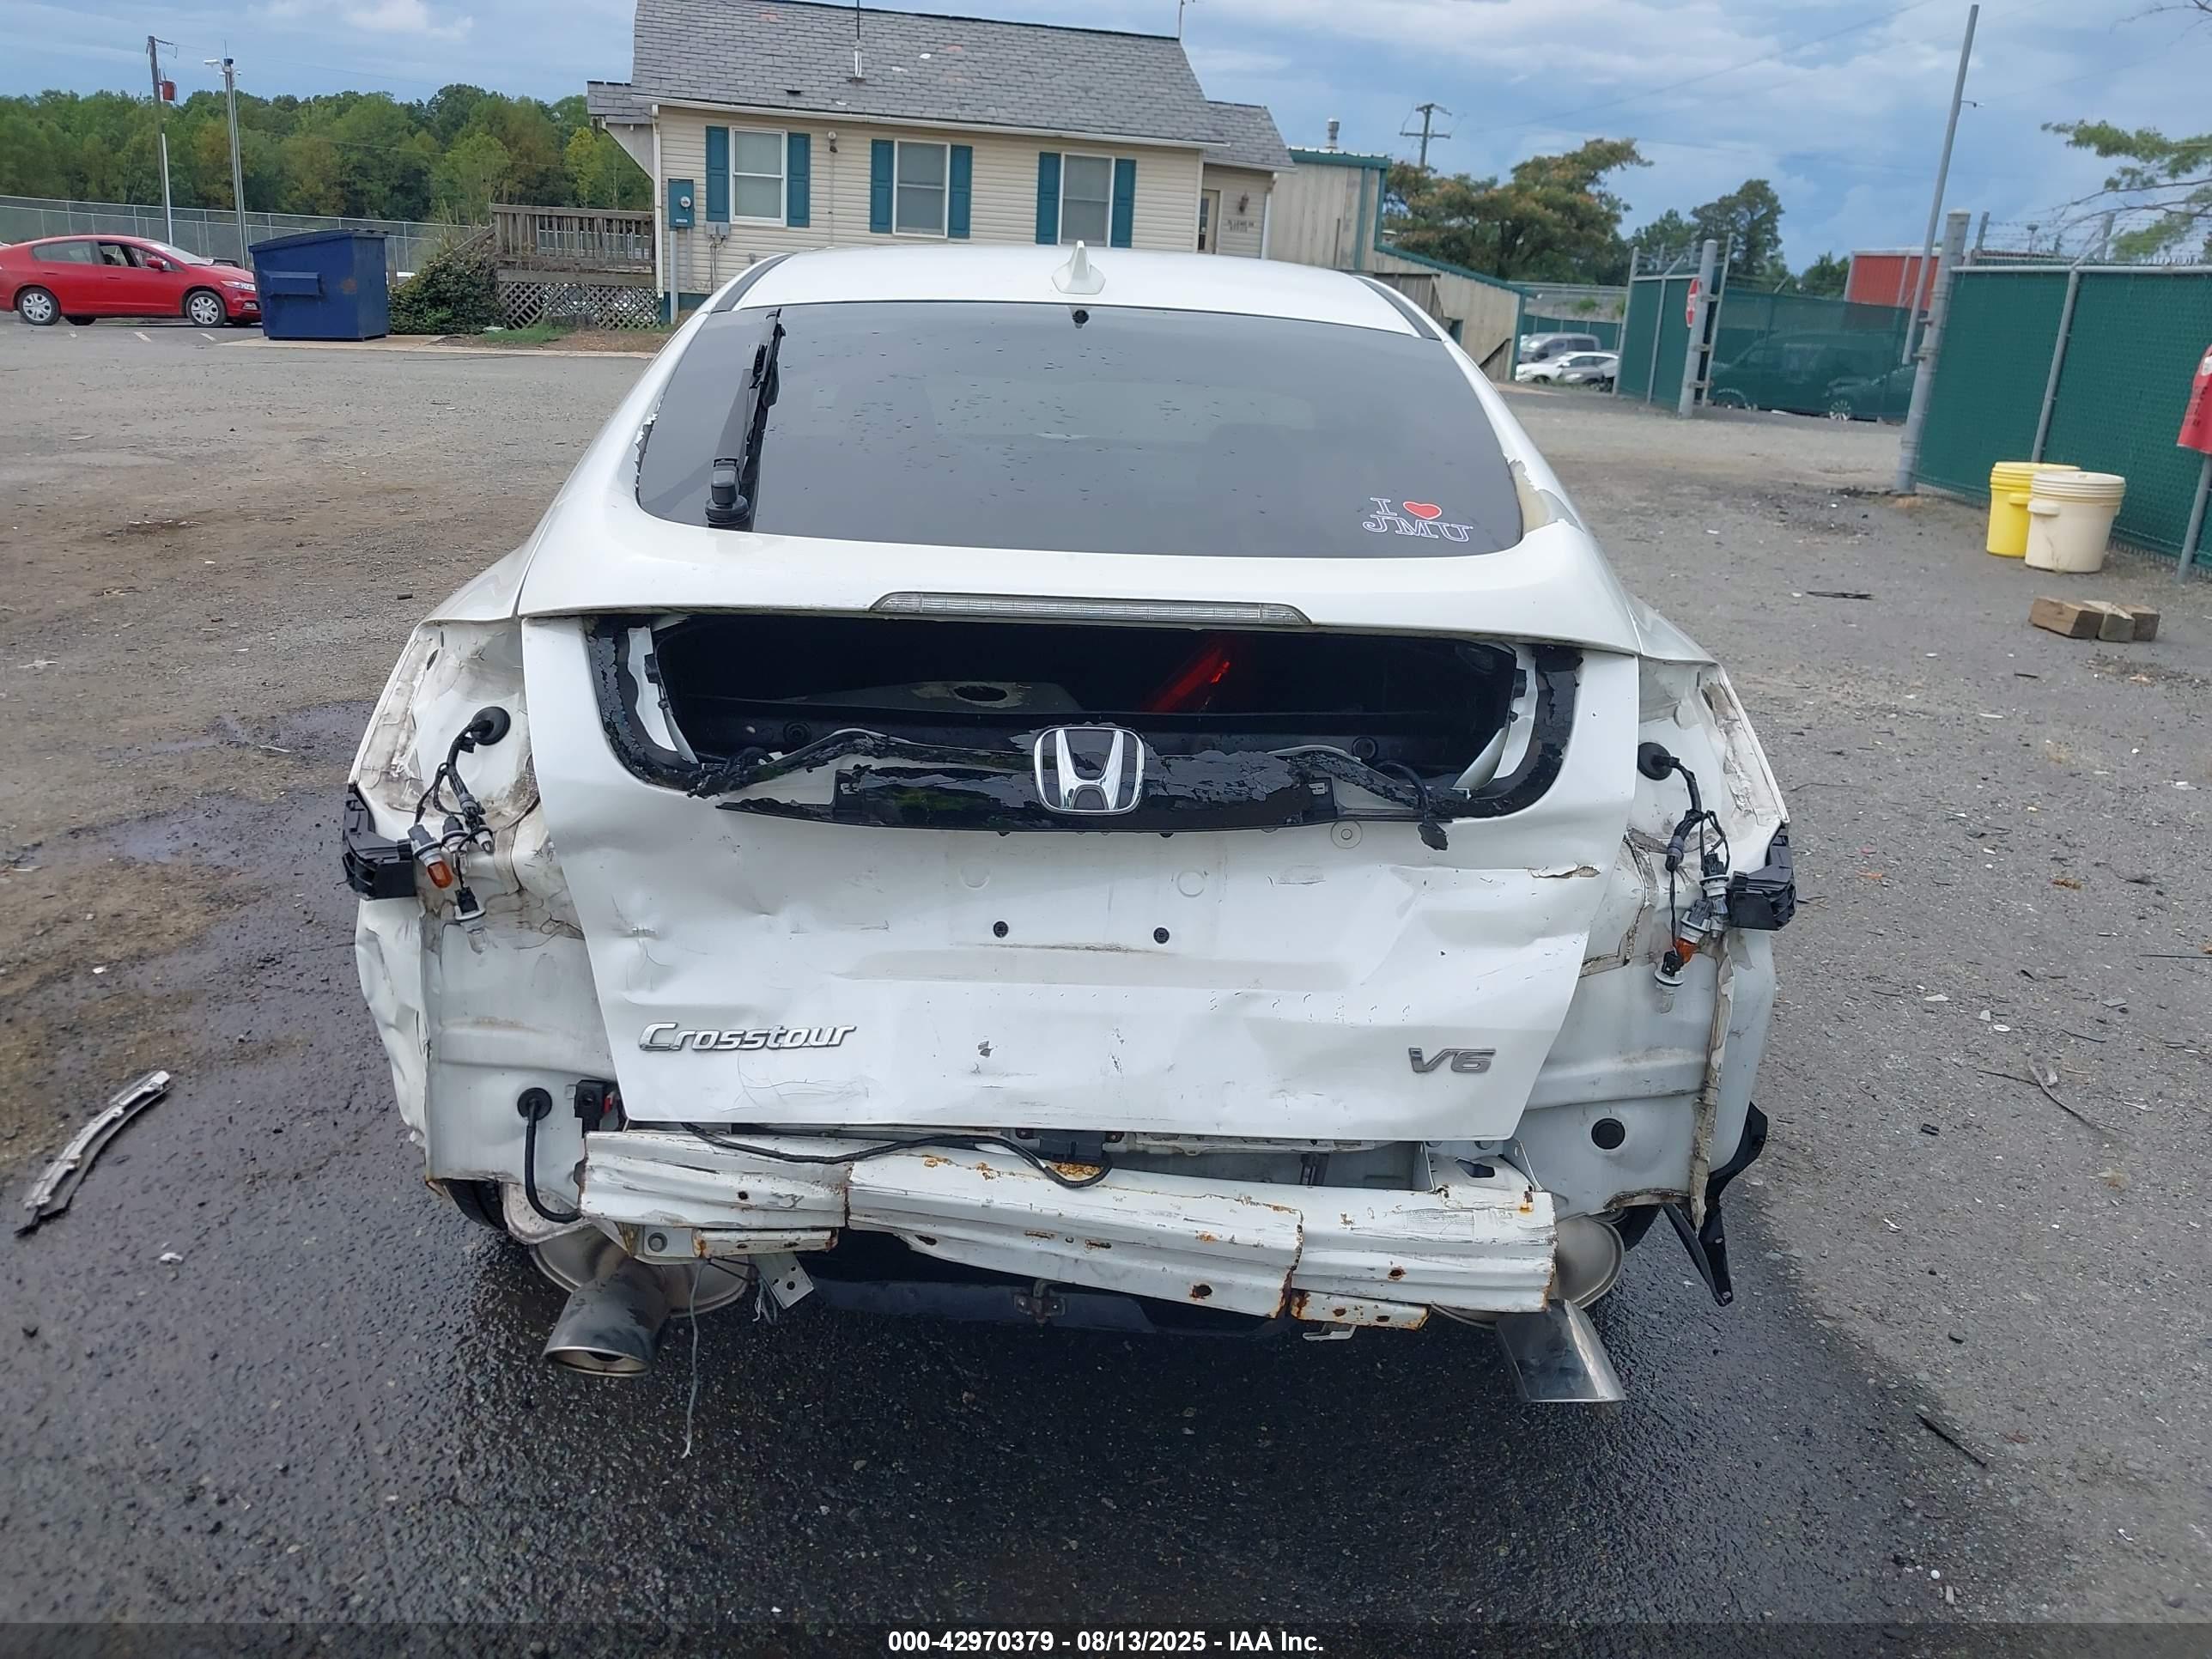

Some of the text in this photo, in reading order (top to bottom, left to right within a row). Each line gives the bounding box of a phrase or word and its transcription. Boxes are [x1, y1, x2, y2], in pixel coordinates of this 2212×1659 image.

[1370, 496, 1398, 517] I
[1362, 514, 1474, 543] JMU
[639, 1022, 857, 1051] Crosstour
[1408, 1047, 1496, 1073] V6
